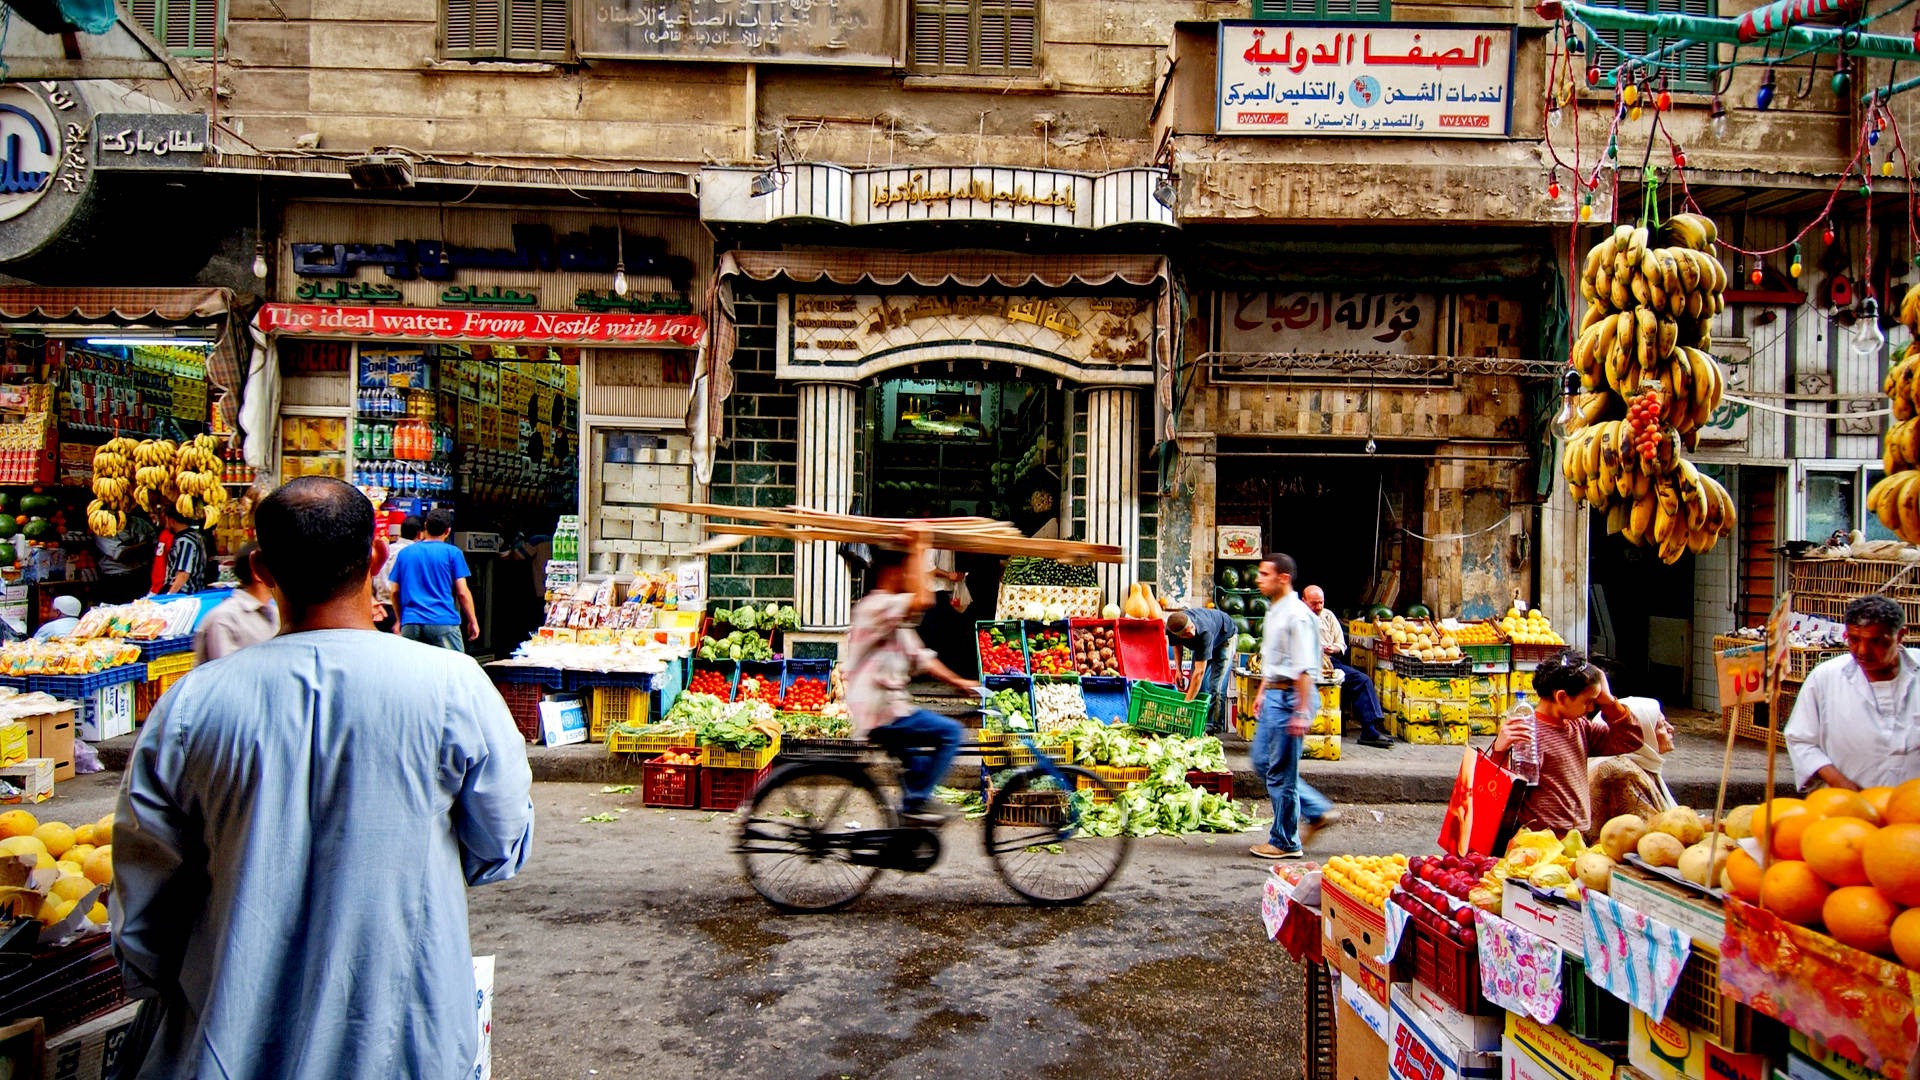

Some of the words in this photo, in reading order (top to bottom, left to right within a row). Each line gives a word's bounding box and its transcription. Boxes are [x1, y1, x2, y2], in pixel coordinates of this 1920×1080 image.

[1243, 28, 1356, 74] الدولية
[1364, 33, 1492, 71] الصفا
[1276, 81, 1345, 106] والتخليص
[1384, 82, 1442, 105] الشحن
[1446, 83, 1503, 103] لخدمات
[102, 128, 155, 155] ماركت
[153, 130, 205, 156] سلطان
[267, 308, 313, 326] The
[319, 309, 375, 328] ideal
[382, 315, 453, 331] water.
[461, 311, 526, 332] From
[533, 315, 600, 335] Nestlé
[606, 317, 657, 336] with
[660, 319, 706, 340] love
[395, 362, 418, 373] OMO
